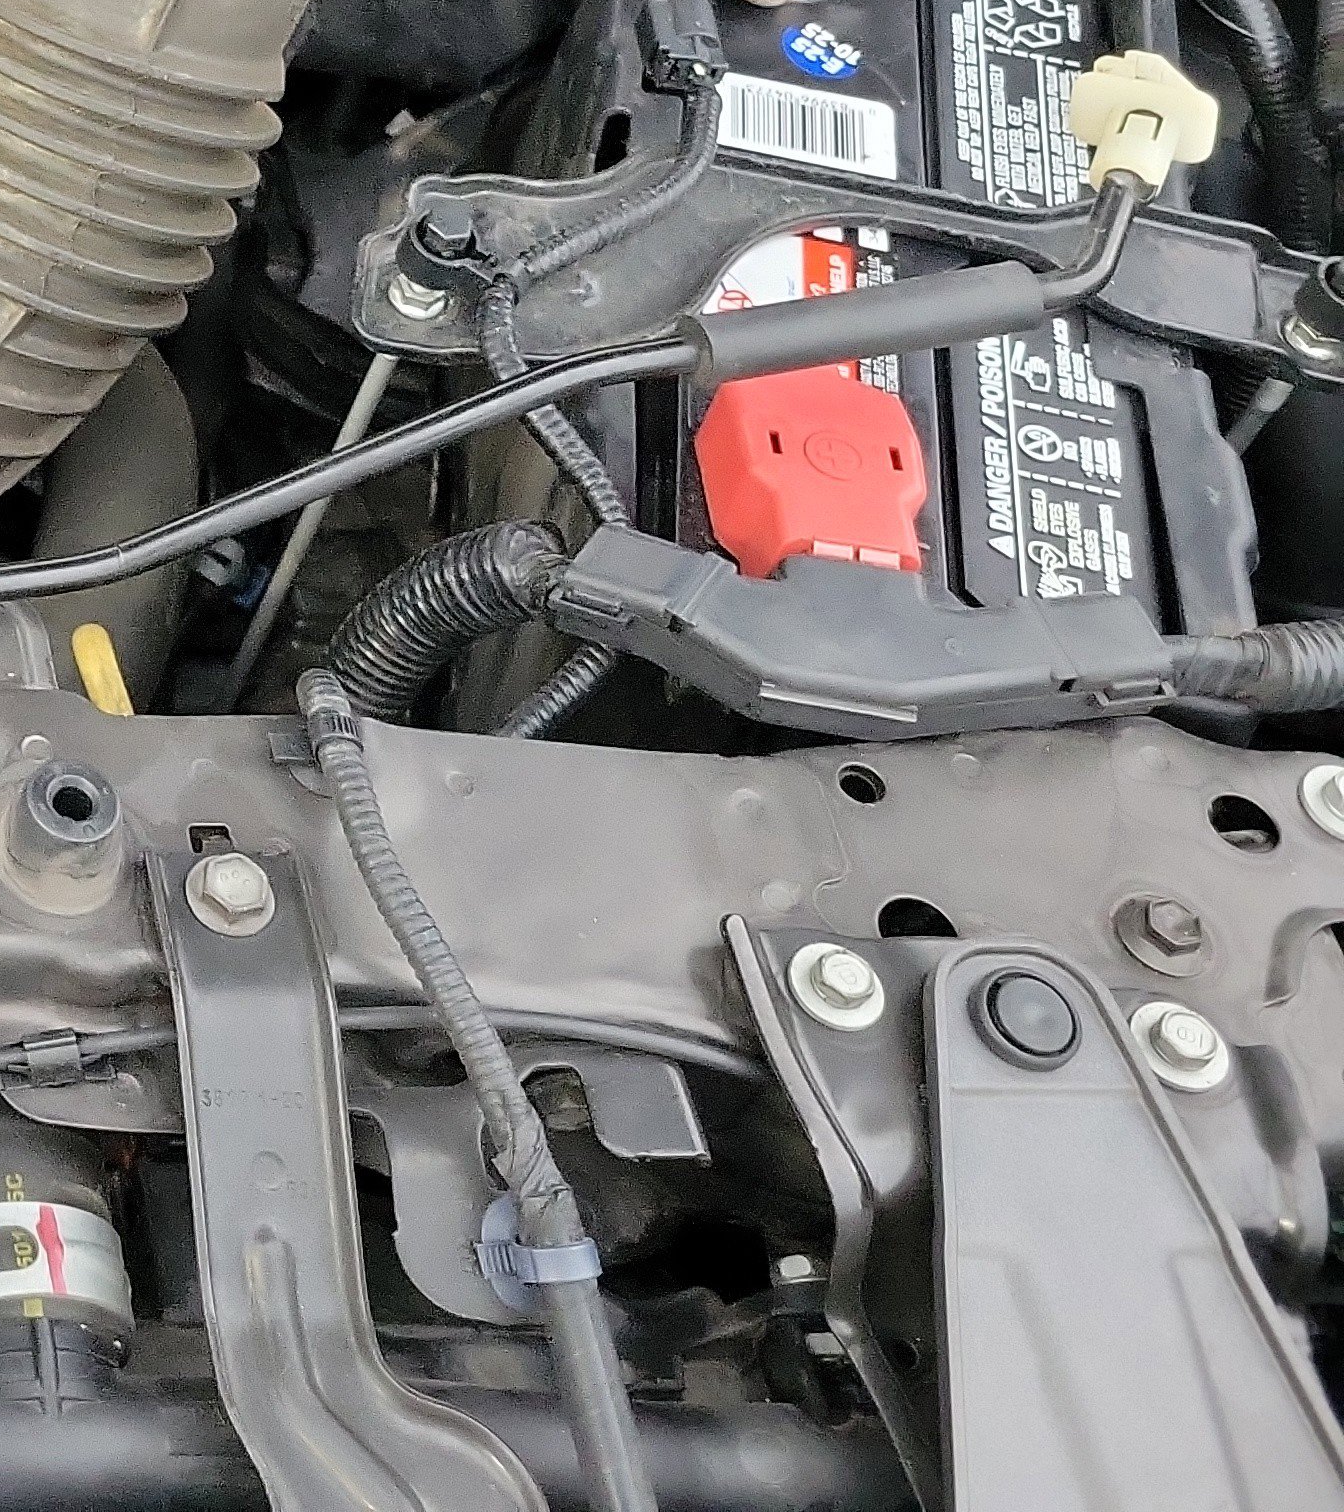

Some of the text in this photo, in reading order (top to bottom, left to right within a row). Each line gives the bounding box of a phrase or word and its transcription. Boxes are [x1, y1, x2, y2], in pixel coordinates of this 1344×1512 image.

[790, 35, 846, 76] E-25
[803, 22, 862, 64] 10-25
[1032, 488, 1049, 532] SHIELD
[1049, 503, 1065, 536] EYES
[1063, 501, 1084, 568] EXPLOSIVE
[1084, 529, 1102, 571] GASES
